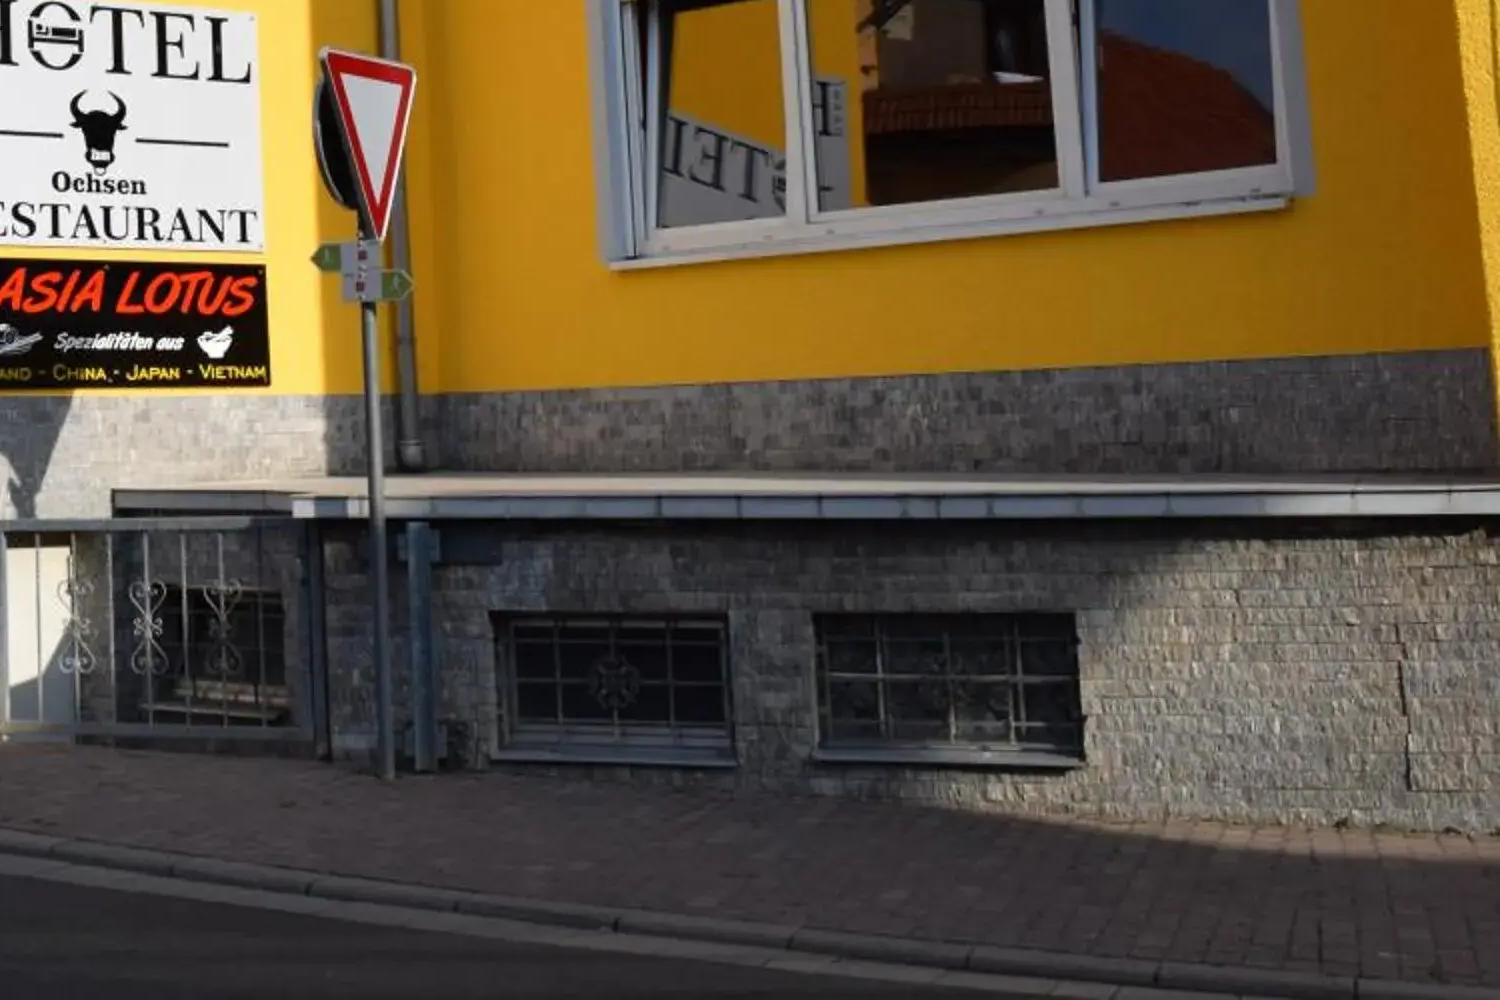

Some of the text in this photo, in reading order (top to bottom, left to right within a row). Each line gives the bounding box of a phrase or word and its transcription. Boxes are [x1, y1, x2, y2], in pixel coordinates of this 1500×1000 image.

[52, 171, 148, 195] Ochsen
[115, 270, 258, 316] LOTUS
[53, 332, 184, 351] Spezialitäten aus
[52, 363, 106, 381] CHINA
[126, 363, 181, 381] JAPAN
[199, 363, 266, 381] VIETNAM
